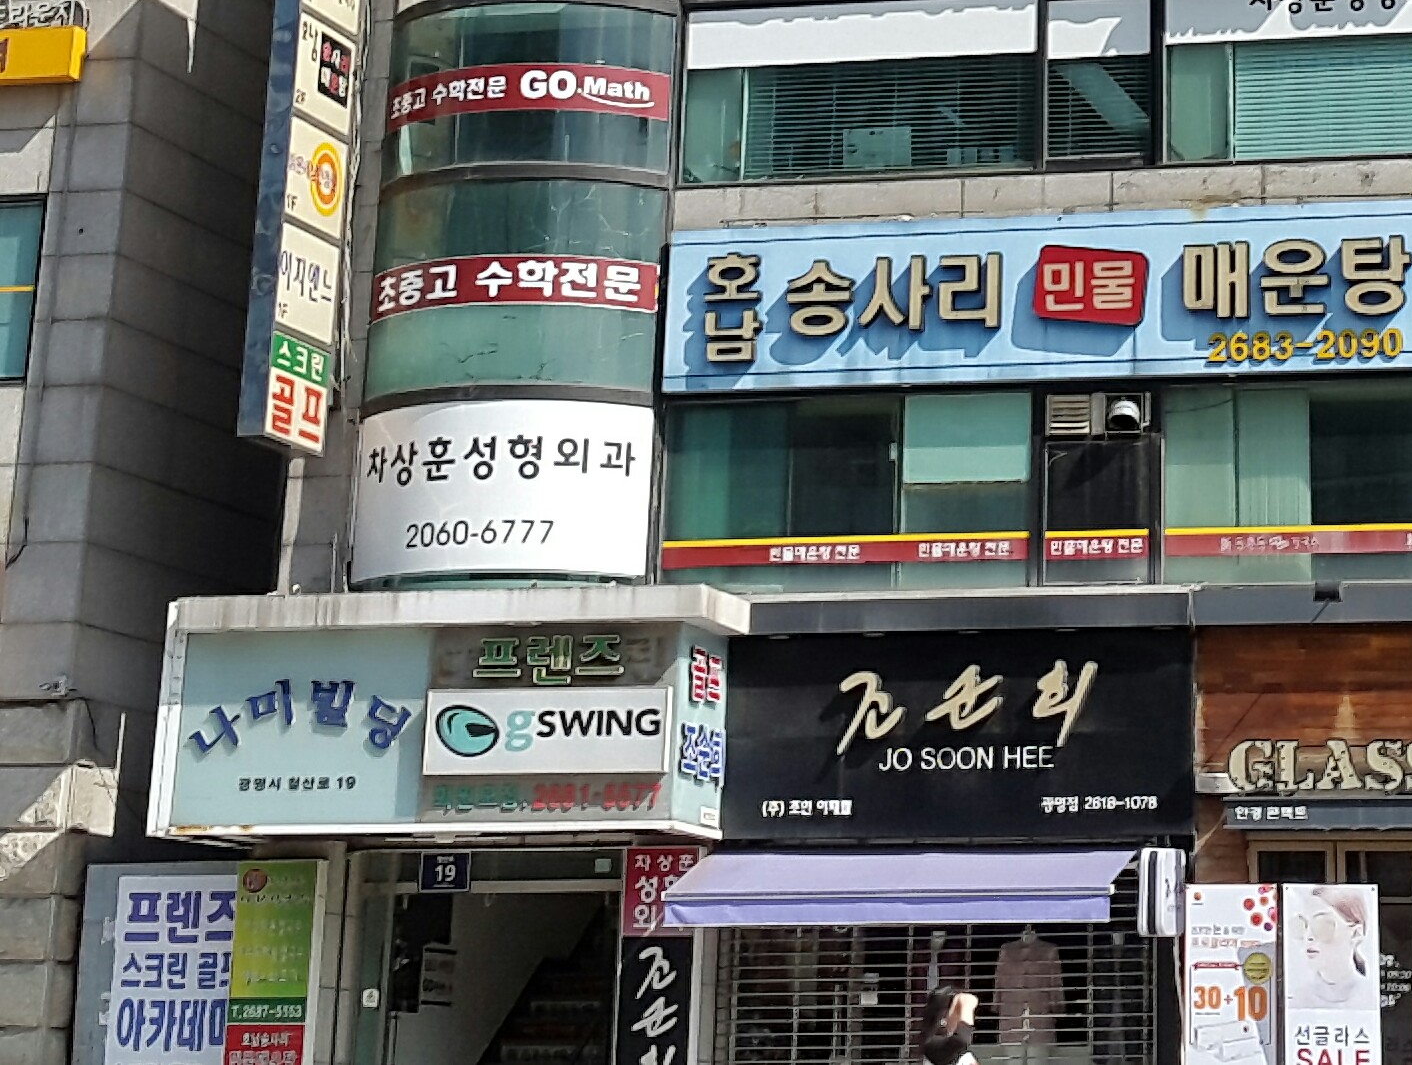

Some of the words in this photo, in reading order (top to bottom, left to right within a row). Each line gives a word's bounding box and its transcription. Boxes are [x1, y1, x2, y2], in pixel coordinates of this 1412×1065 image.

[431, 75, 507, 106] 수학전문
[377, 264, 457, 313] 초중고
[475, 260, 641, 303] 수학전문
[703, 251, 761, 364] 호남
[785, 250, 1003, 339] 송사리
[1041, 259, 1137, 315] 민물
[1182, 234, 1410, 320] 매운탕
[274, 339, 324, 383] 스크린
[1209, 328, 1405, 365] 2683-2090
[272, 373, 322, 444] 골프
[405, 520, 554, 549] 2060-6777
[472, 635, 625, 686] 프렌즈
[878, 746, 913, 772] JO
[920, 746, 994, 771] SOON
[1003, 745, 1055, 770] HEE
[337, 776, 356, 790] 19
[435, 865, 456, 882] 19
[120, 952, 188, 989] 스크린
[1295, 1025, 1371, 1046] 선글라스
[1297, 1048, 1370, 1065] SALE
